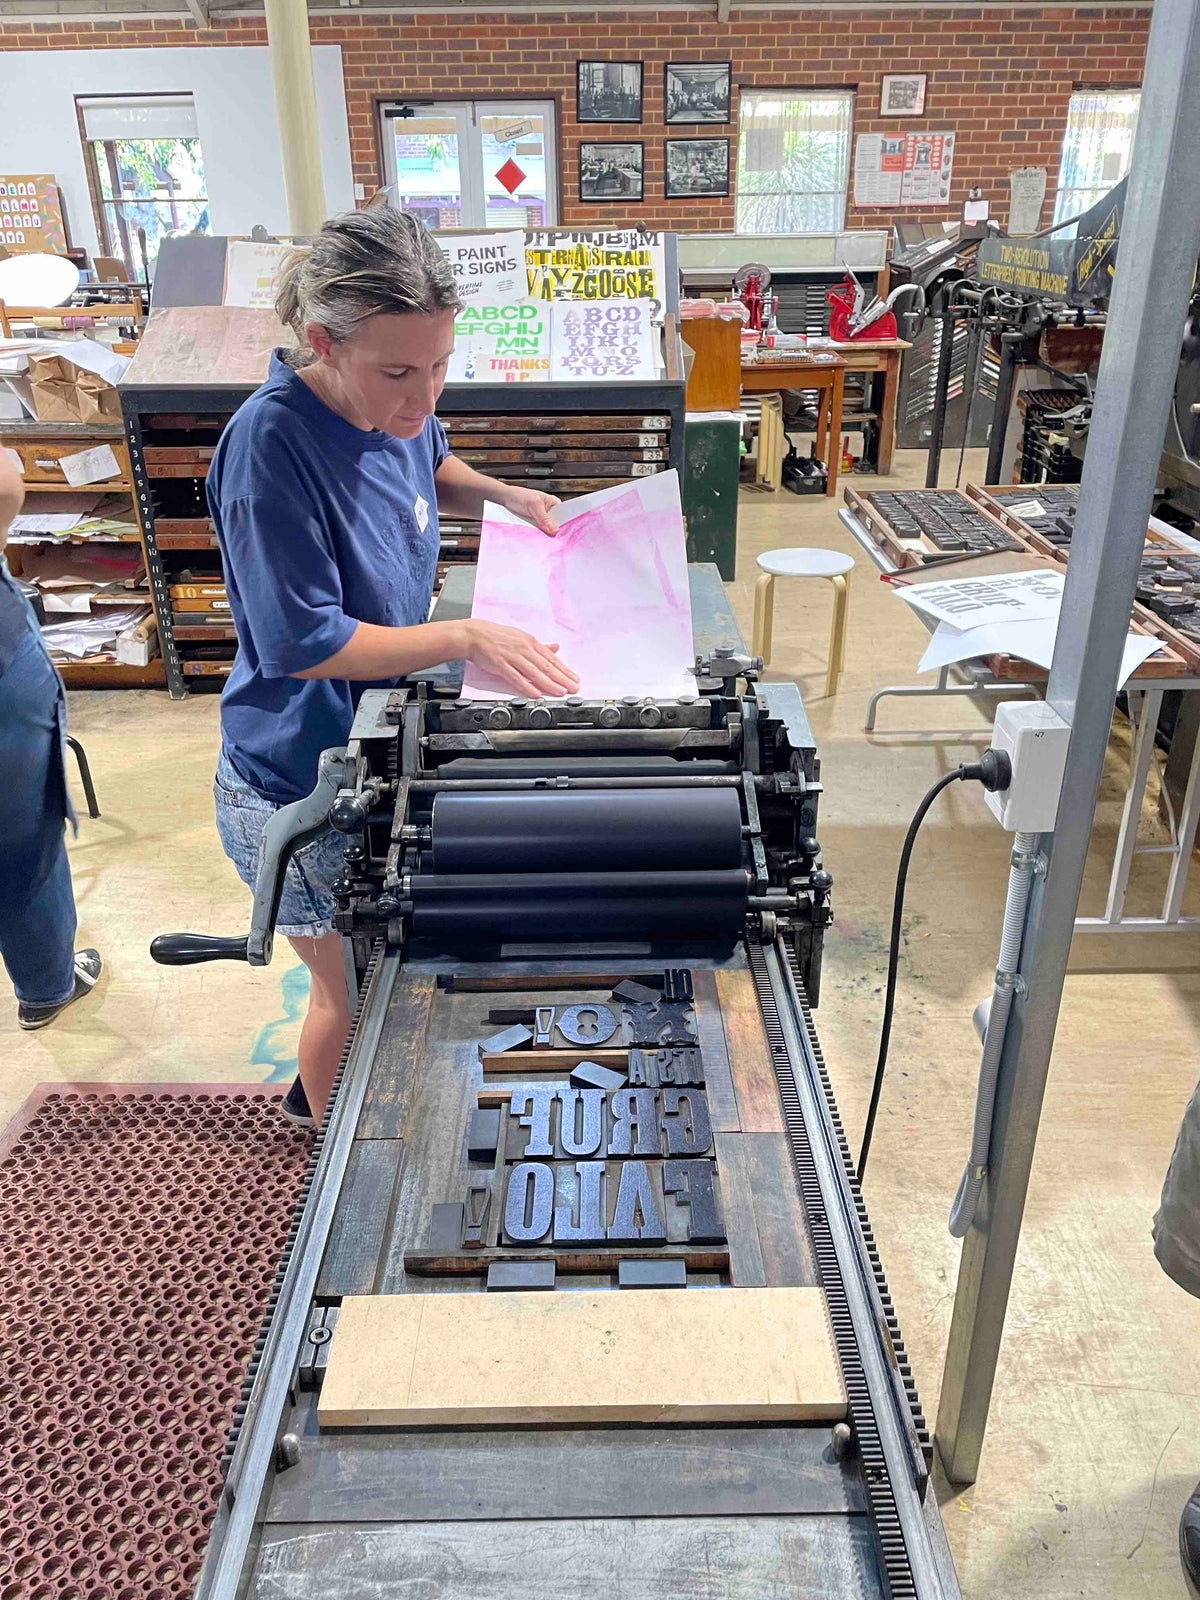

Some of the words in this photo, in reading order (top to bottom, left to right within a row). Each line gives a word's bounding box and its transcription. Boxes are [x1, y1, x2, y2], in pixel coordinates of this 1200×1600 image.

[457, 245, 507, 260] PAINT
[468, 258, 517, 275] SIGNS
[1040, 271, 1069, 295] MACHINE
[461, 305, 538, 321] ABCD
[454, 321, 543, 336] EFGHIJ
[490, 359, 550, 371] THANKS
[129, 420, 133, 429] 1
[130, 435, 136, 443] 2
[643, 437, 656, 446] 37
[133, 450, 139, 458] 3
[135, 464, 141, 472] 4
[140, 493, 146, 501] 6
[142, 507, 148, 515] 7
[145, 521, 151, 529] 8
[147, 534, 154, 543] 9
